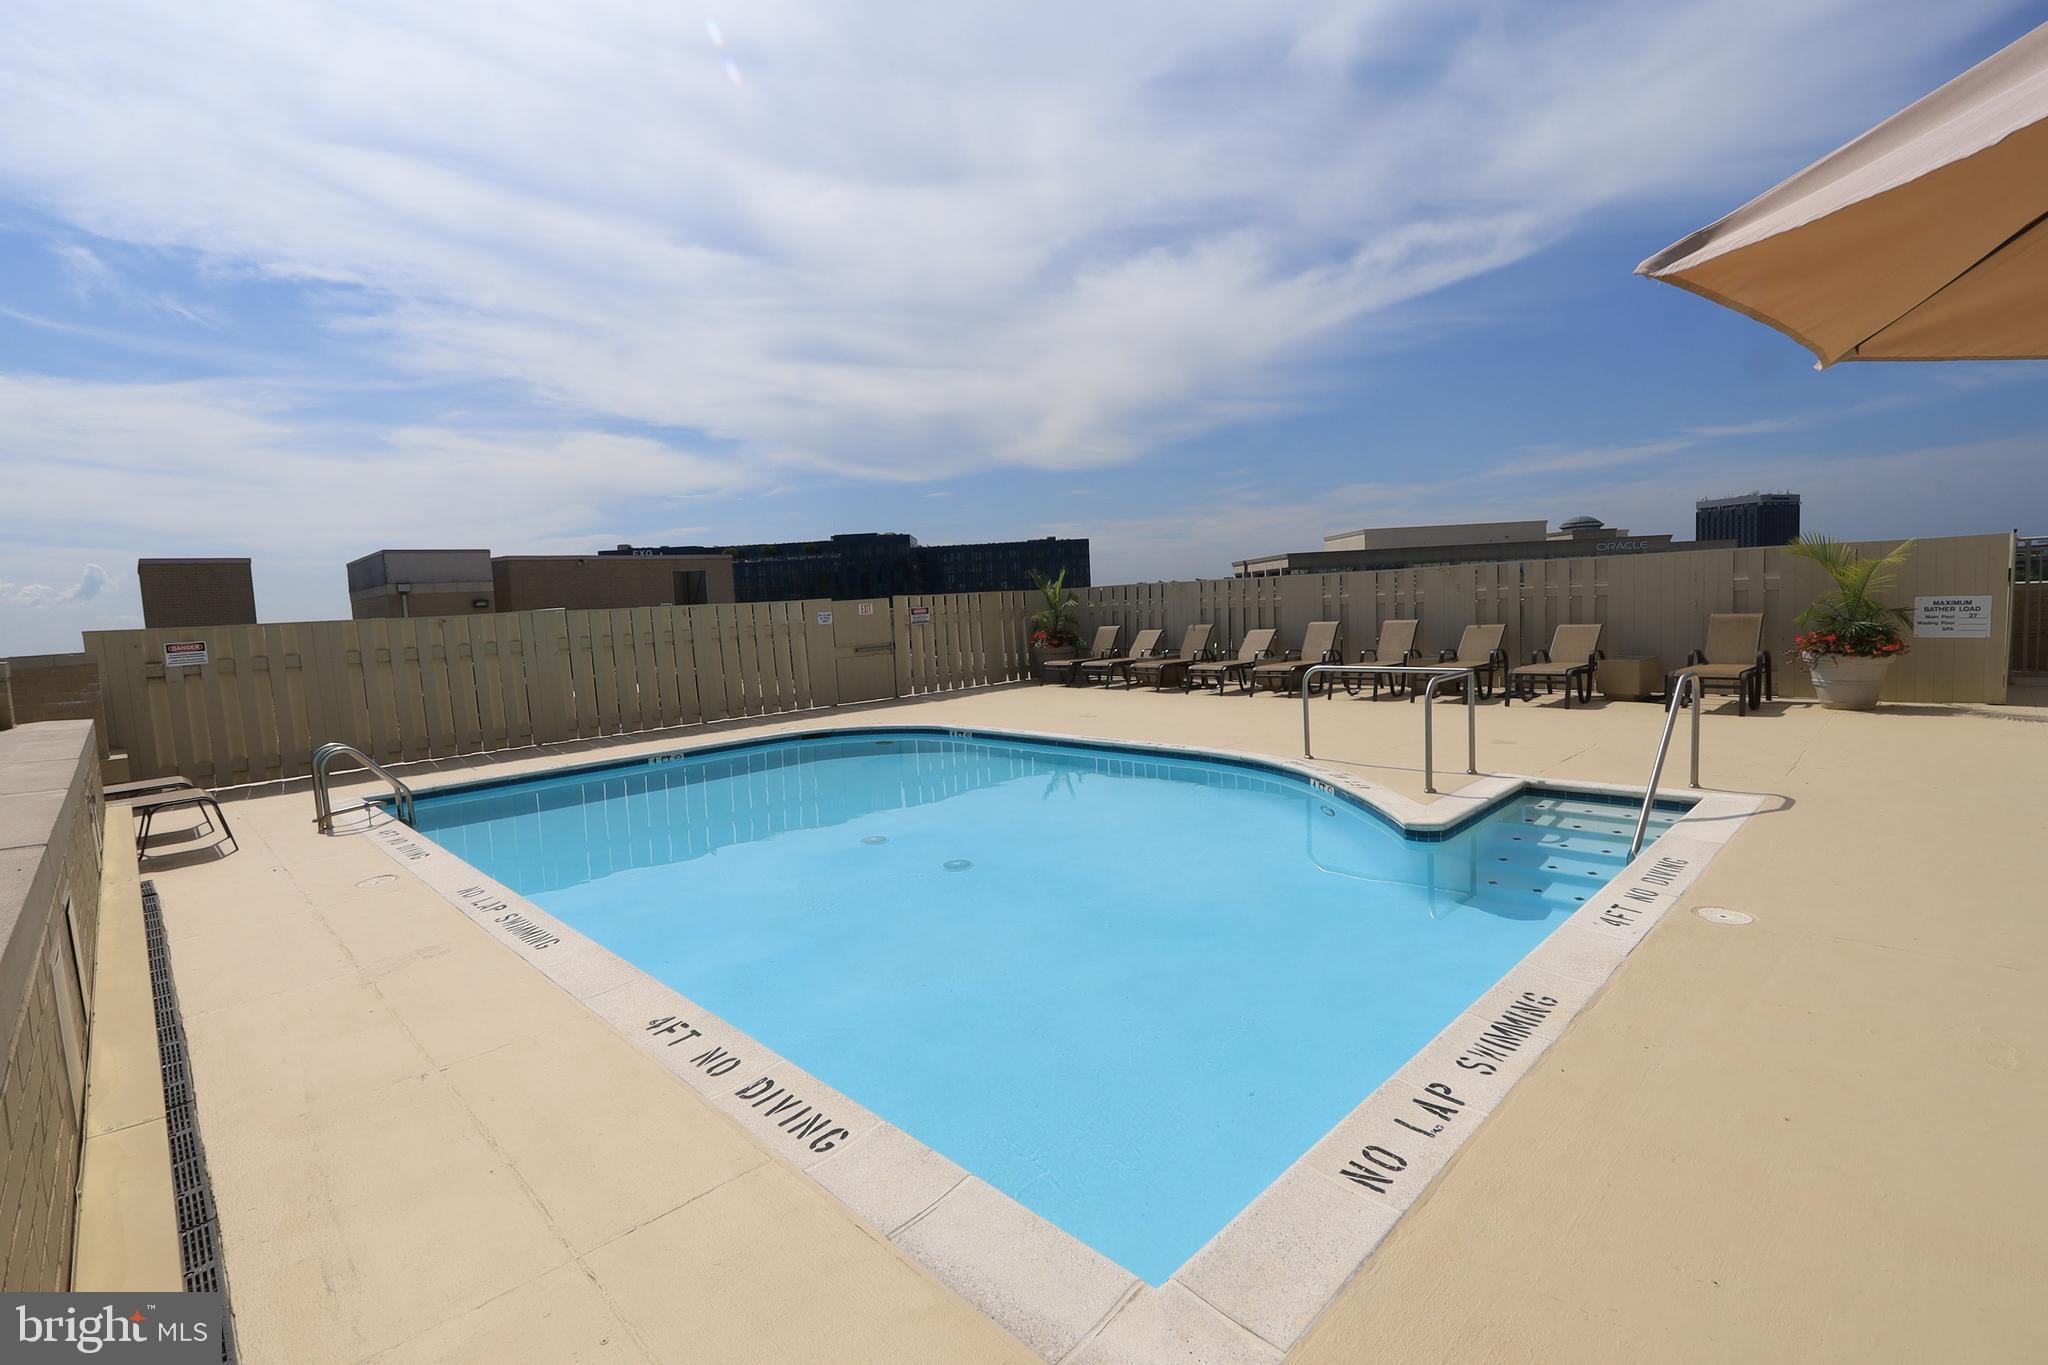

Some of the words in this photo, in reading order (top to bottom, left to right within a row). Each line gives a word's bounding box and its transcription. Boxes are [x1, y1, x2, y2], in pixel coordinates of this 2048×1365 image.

[1595, 541, 1649, 551] ORACLE
[396, 843, 431, 861] DIVING
[1640, 856, 1689, 887] DIVING
[456, 885, 485, 899] NO
[1624, 887, 1660, 904] NO
[470, 896, 508, 913] LAP
[1599, 903, 1643, 927] 4FT
[494, 912, 561, 951] SWIMMING
[645, 1016, 703, 1047] 4FT
[689, 1046, 742, 1077] NO
[734, 1076, 850, 1153] DIVING
[1338, 1145, 1408, 1195] NO
[1393, 1082, 1466, 1139] LAP
[1455, 991, 1559, 1076] SWIMMING
